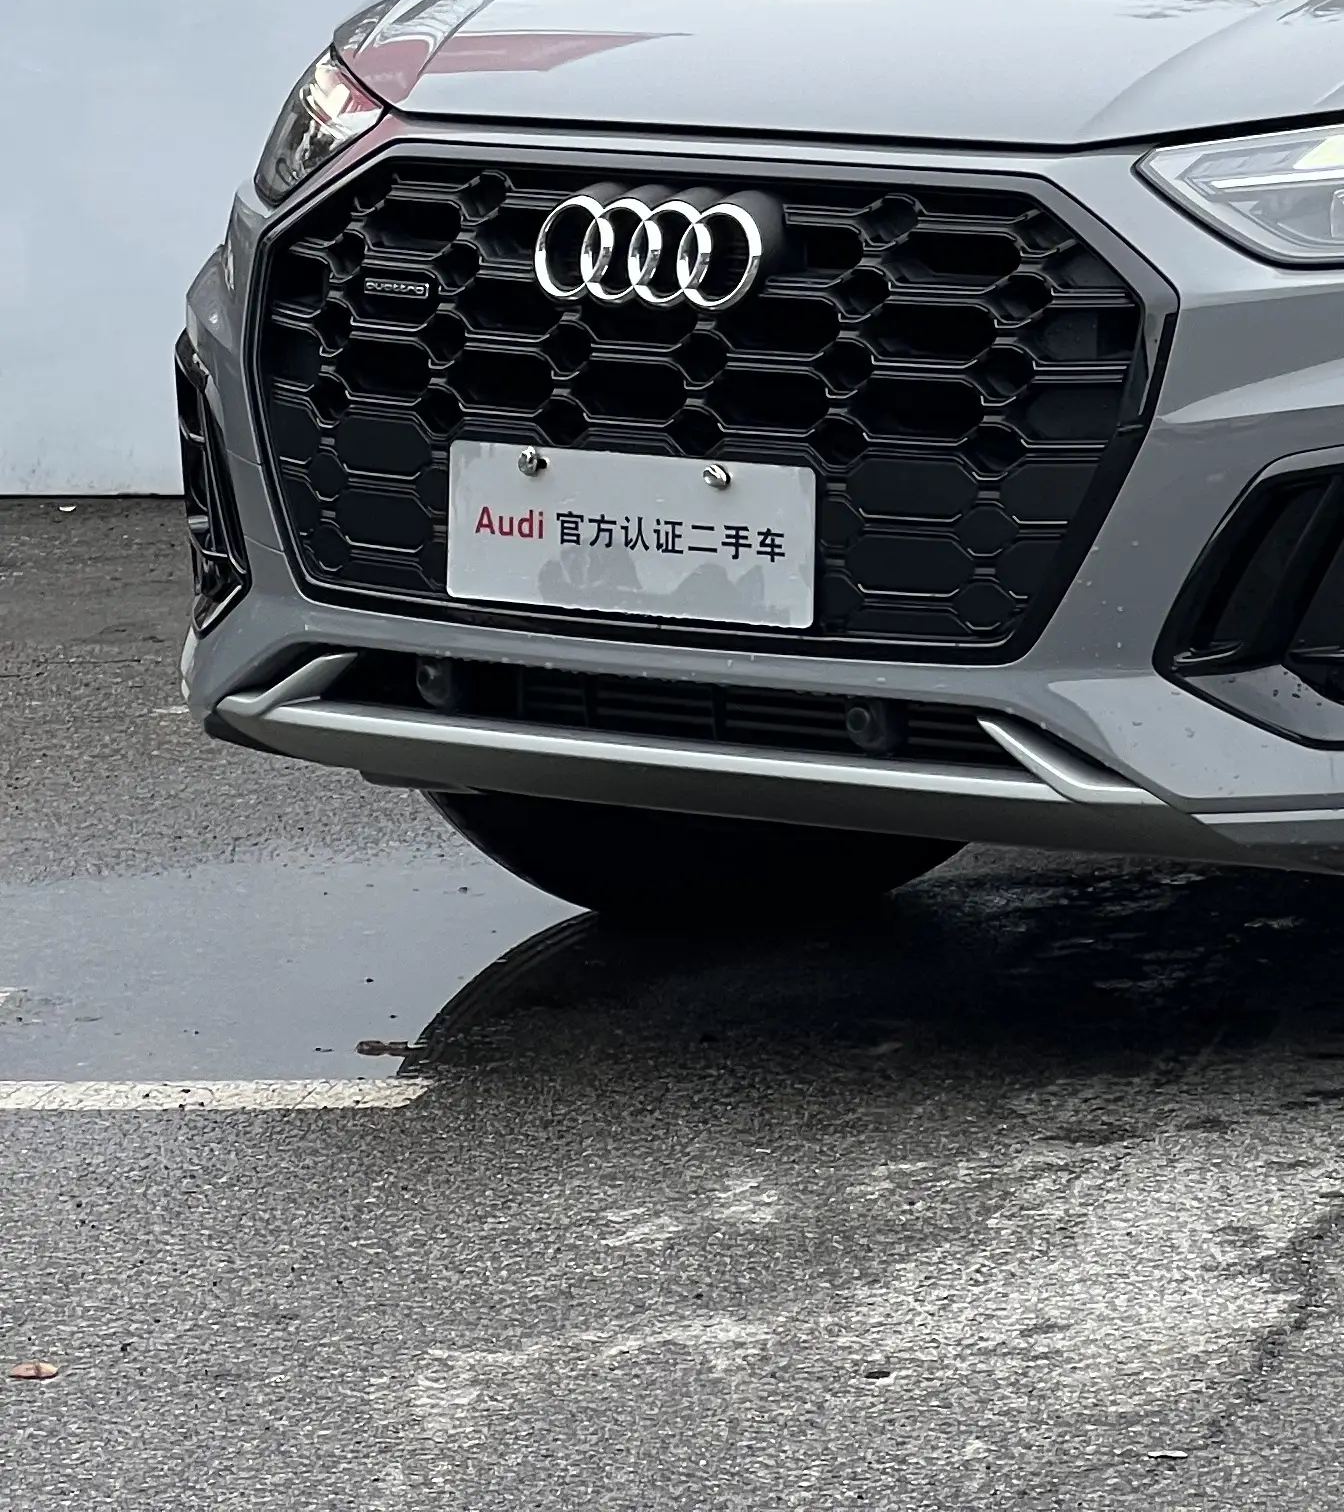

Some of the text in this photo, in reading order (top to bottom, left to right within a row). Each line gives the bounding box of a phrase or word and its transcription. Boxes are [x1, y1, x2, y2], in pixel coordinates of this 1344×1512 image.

[475, 506, 786, 563] Audi 官方认证二手车
